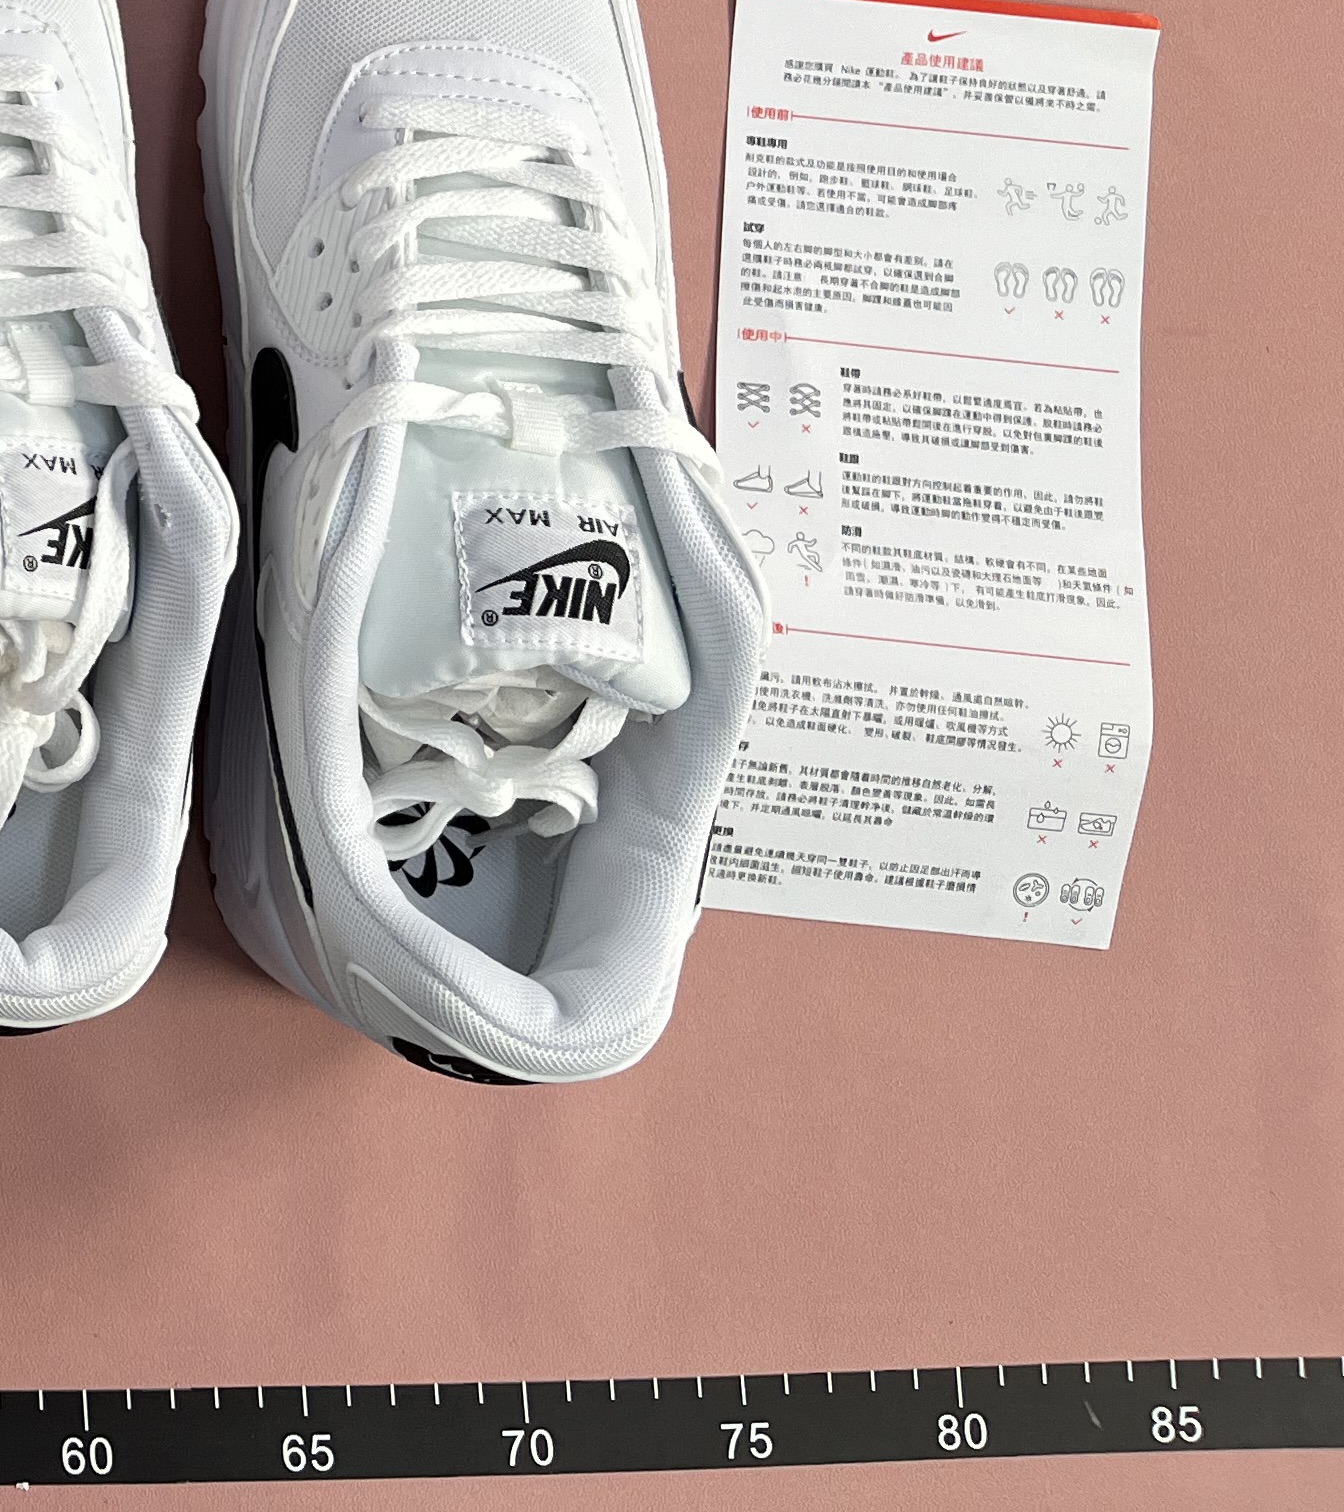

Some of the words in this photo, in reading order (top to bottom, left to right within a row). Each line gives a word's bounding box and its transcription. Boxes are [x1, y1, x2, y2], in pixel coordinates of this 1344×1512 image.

[839, 64, 861, 75] Nike
[740, 327, 784, 344] 使用中
[22, 453, 78, 475] MAX
[484, 507, 552, 528] MAX
[576, 515, 620, 537] AIR
[41, 523, 95, 570] KE
[502, 573, 618, 626] NIKE
[720, 1422, 773, 1460] 75
[937, 1413, 988, 1451] 80
[1151, 1405, 1203, 1444] 85
[61, 1437, 113, 1475] 60
[282, 1433, 335, 1473] 65
[501, 1428, 554, 1467] 70
